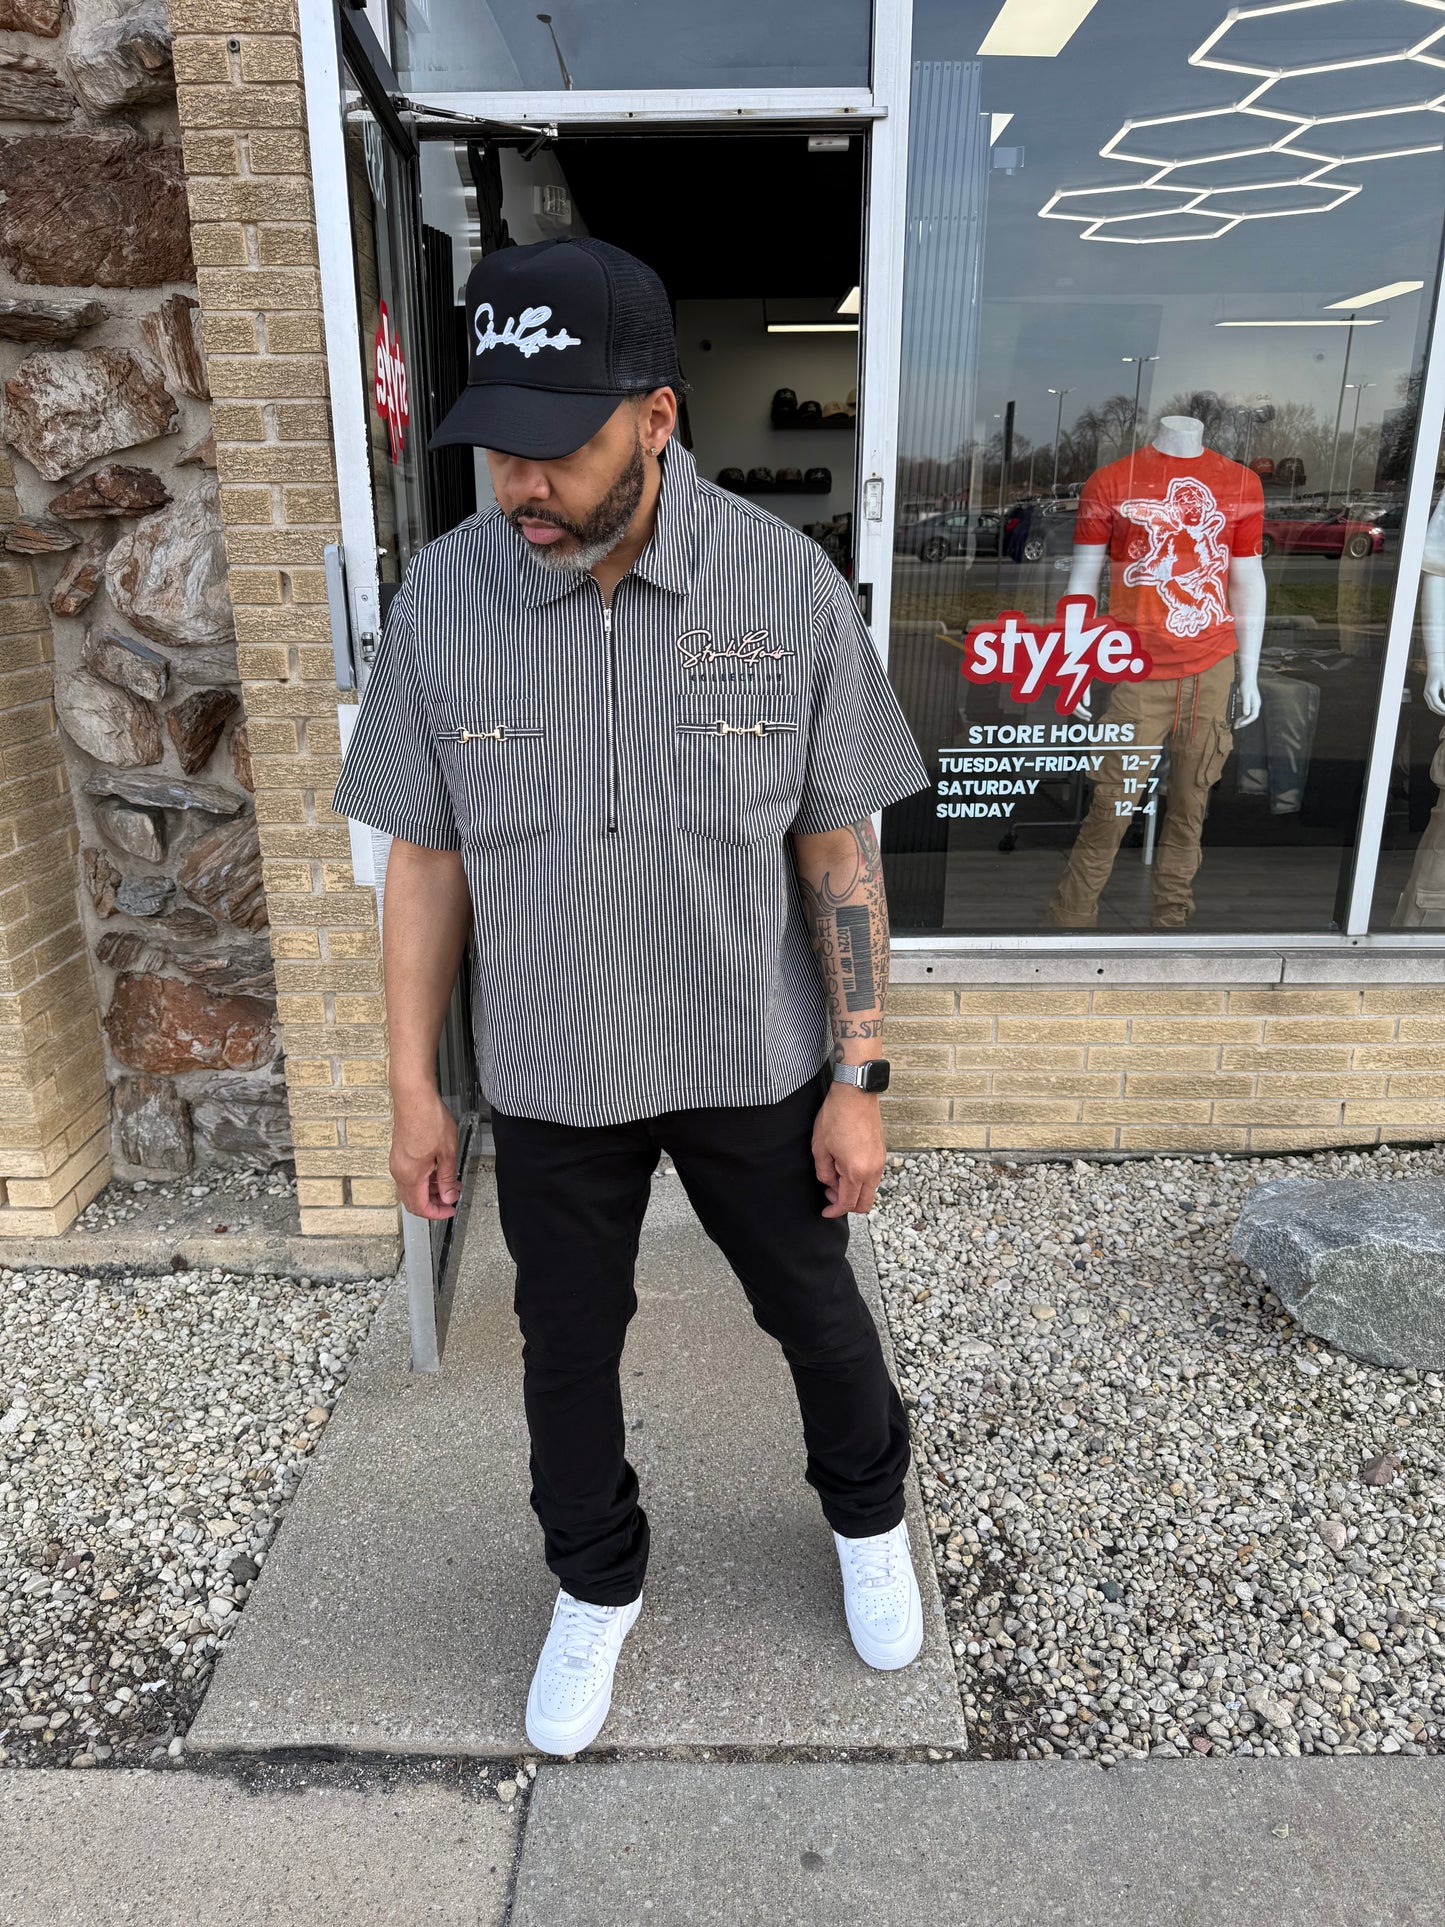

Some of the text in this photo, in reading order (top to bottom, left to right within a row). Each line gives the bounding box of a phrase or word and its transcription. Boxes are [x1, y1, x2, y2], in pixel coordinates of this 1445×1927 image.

[968, 723, 1135, 744] STORE HOURS
[938, 754, 1162, 773] TUESDAY-FRIDAY 12-7
[937, 777, 1160, 796] SATURDAY 11-7
[936, 800, 1156, 819] SUNDAY 12-4
[837, 928, 851, 953] 0224
[817, 918, 842, 1016] HONOR
